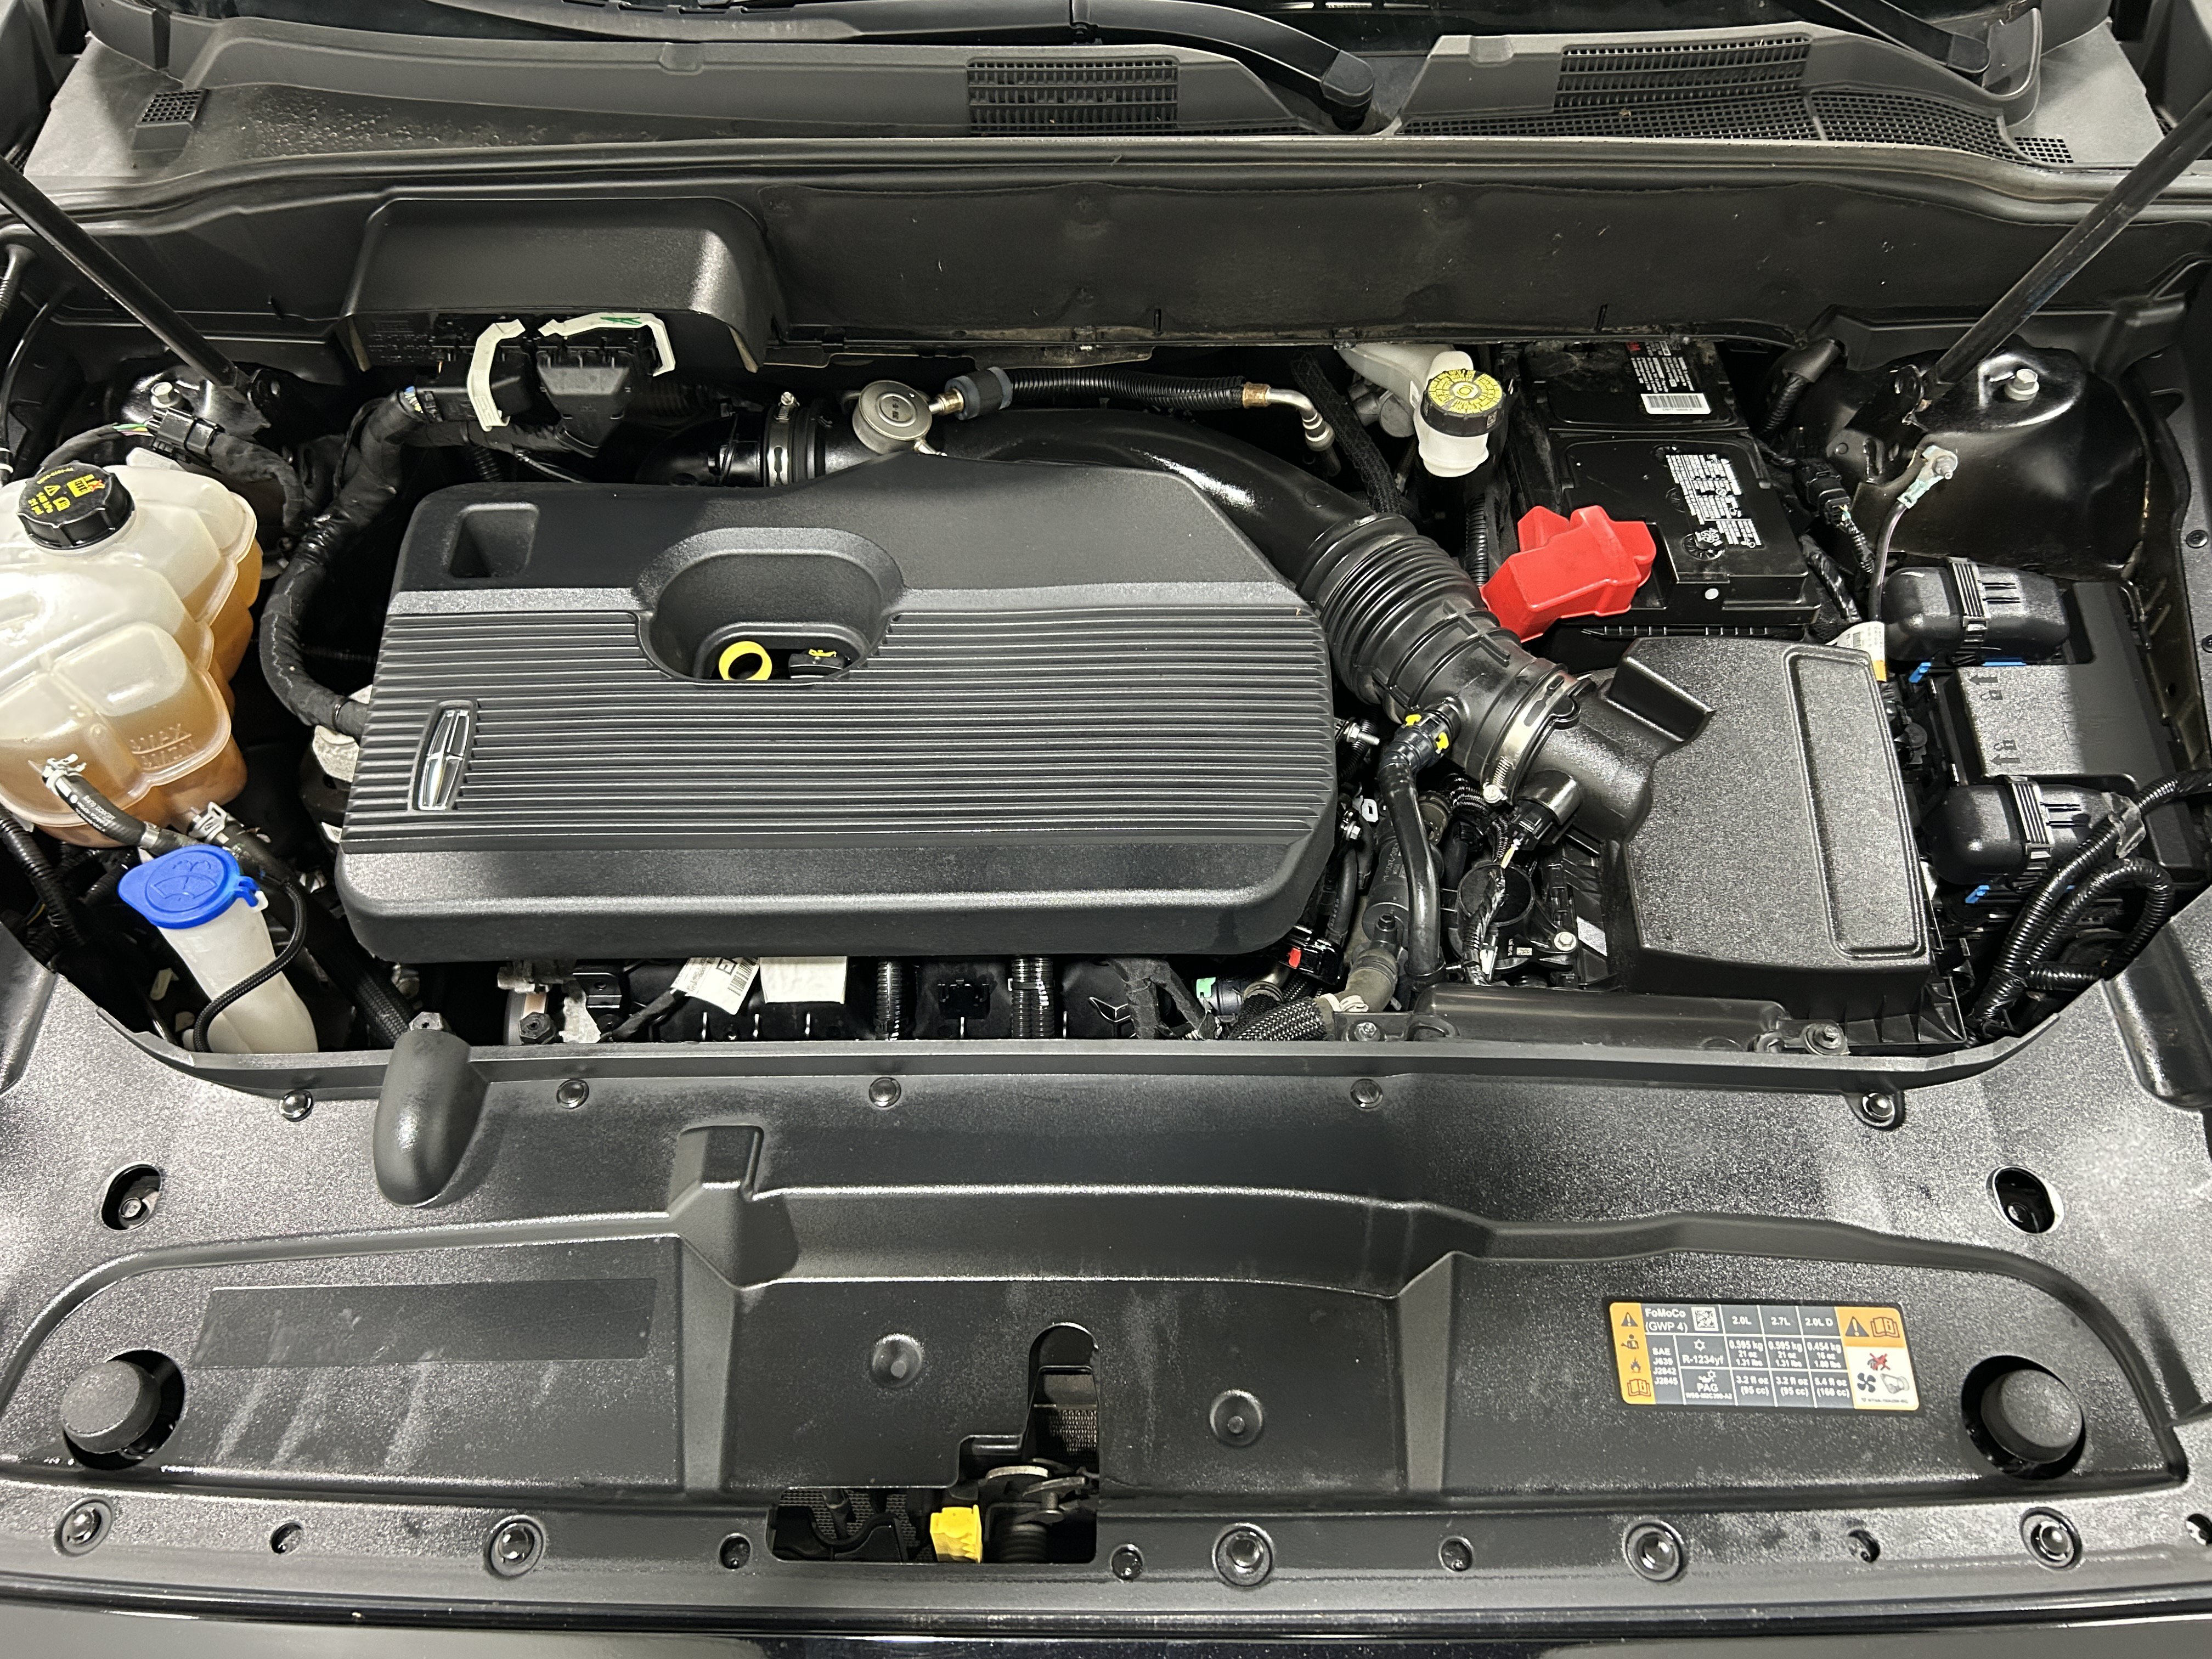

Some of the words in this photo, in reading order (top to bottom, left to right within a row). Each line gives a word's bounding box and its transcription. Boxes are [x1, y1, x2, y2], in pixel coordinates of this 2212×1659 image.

[1645, 1308, 1686, 1318] FoMoCo
[1732, 1316, 1752, 1325] 2.0L
[1771, 1317, 1791, 1325] 2.7L
[1805, 1318, 1825, 1327] 2.0L
[1826, 1318, 1833, 1327] D
[1645, 1322, 1674, 1333] (GWP
[1677, 1322, 1688, 1333] 4)
[1729, 1340, 1751, 1350] 0.595
[1752, 1340, 1764, 1352] kg
[1768, 1341, 1791, 1350] 0.595
[1792, 1341, 1803, 1353] kg
[1807, 1341, 1829, 1351] 0.454
[1830, 1342, 1842, 1353] kg
[1652, 1347, 1671, 1356] SAE
[1653, 1357, 1673, 1365] J639
[1681, 1355, 1724, 1366] R-1234yf
[1736, 1375, 1749, 1384] 3.2
[1751, 1376, 1756, 1384] fl
[1775, 1376, 1788, 1385] 3.2
[1790, 1376, 1796, 1385] fl
[1814, 1378, 1827, 1386] 5.4
[1829, 1378, 1835, 1386] fl
[1696, 1383, 1718, 1392] PAG
[1740, 1386, 1754, 1396] (95
[1756, 1387, 1769, 1397] cc)
[1780, 1387, 1795, 1397] (95
[1795, 1388, 1809, 1397] cc)
[1836, 1389, 1850, 1398] cc)
